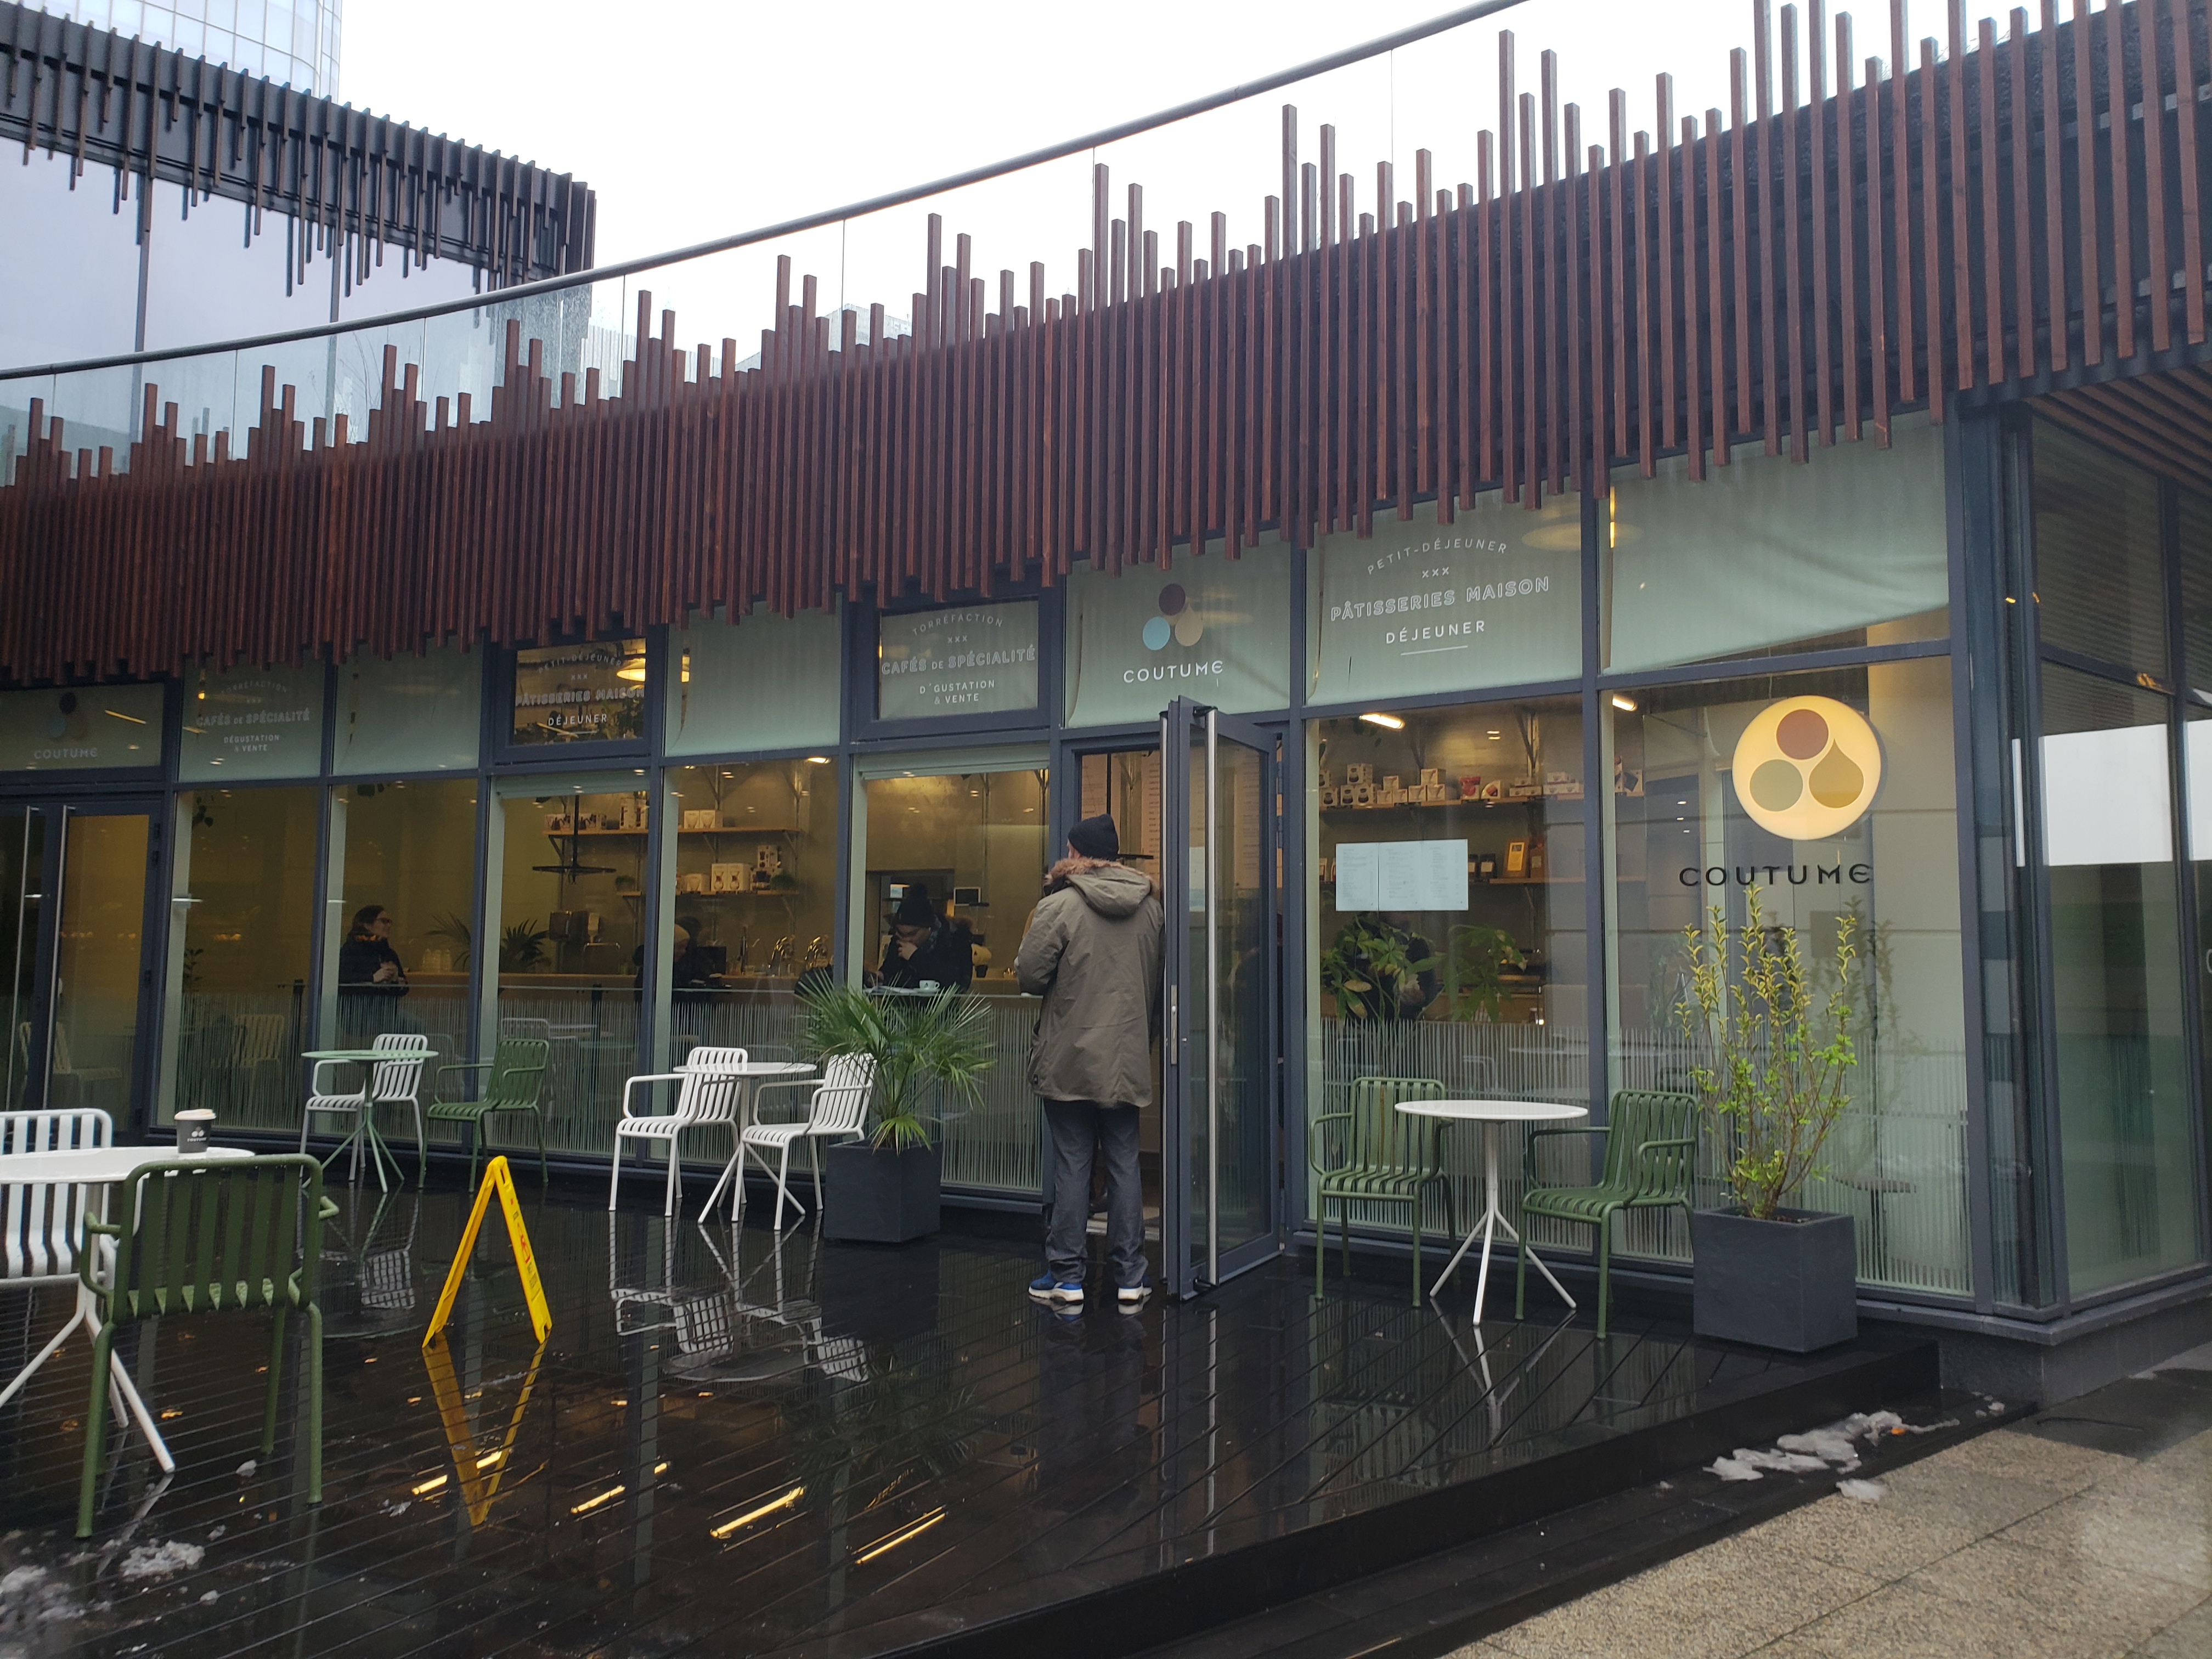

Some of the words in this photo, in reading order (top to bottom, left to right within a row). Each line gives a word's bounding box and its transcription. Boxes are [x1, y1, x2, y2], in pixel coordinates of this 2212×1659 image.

[1367, 538, 1508, 575] PETIT-DÉJEUNER
[1331, 590, 1455, 622] PÂTISSERIES
[1466, 576, 1549, 602] MAISON
[912, 613, 1003, 636] TORRÉFACTION
[1386, 620, 1486, 644] DÉJEUNER
[538, 652, 622, 674] PETIT-DÉJEUNER
[882, 656, 927, 675] CAFÉS
[932, 661, 944, 670] DE
[949, 644, 1036, 669] SPÉCIALITÉ
[1123, 660, 1223, 684] COUTUME
[515, 690, 590, 707] PÂTISSERIES
[596, 687, 645, 701] MAISON
[934, 696, 941, 704] &
[945, 693, 979, 704] VENTE
[196, 713, 230, 726] CAFÉS
[246, 708, 310, 724] SPÉCIALITÉ
[549, 714, 607, 726] DÉJEUNER
[224, 735, 279, 743] DÉGUSTATION
[34, 747, 98, 760] COUTUME
[1679, 864, 1872, 887] COUTUME
